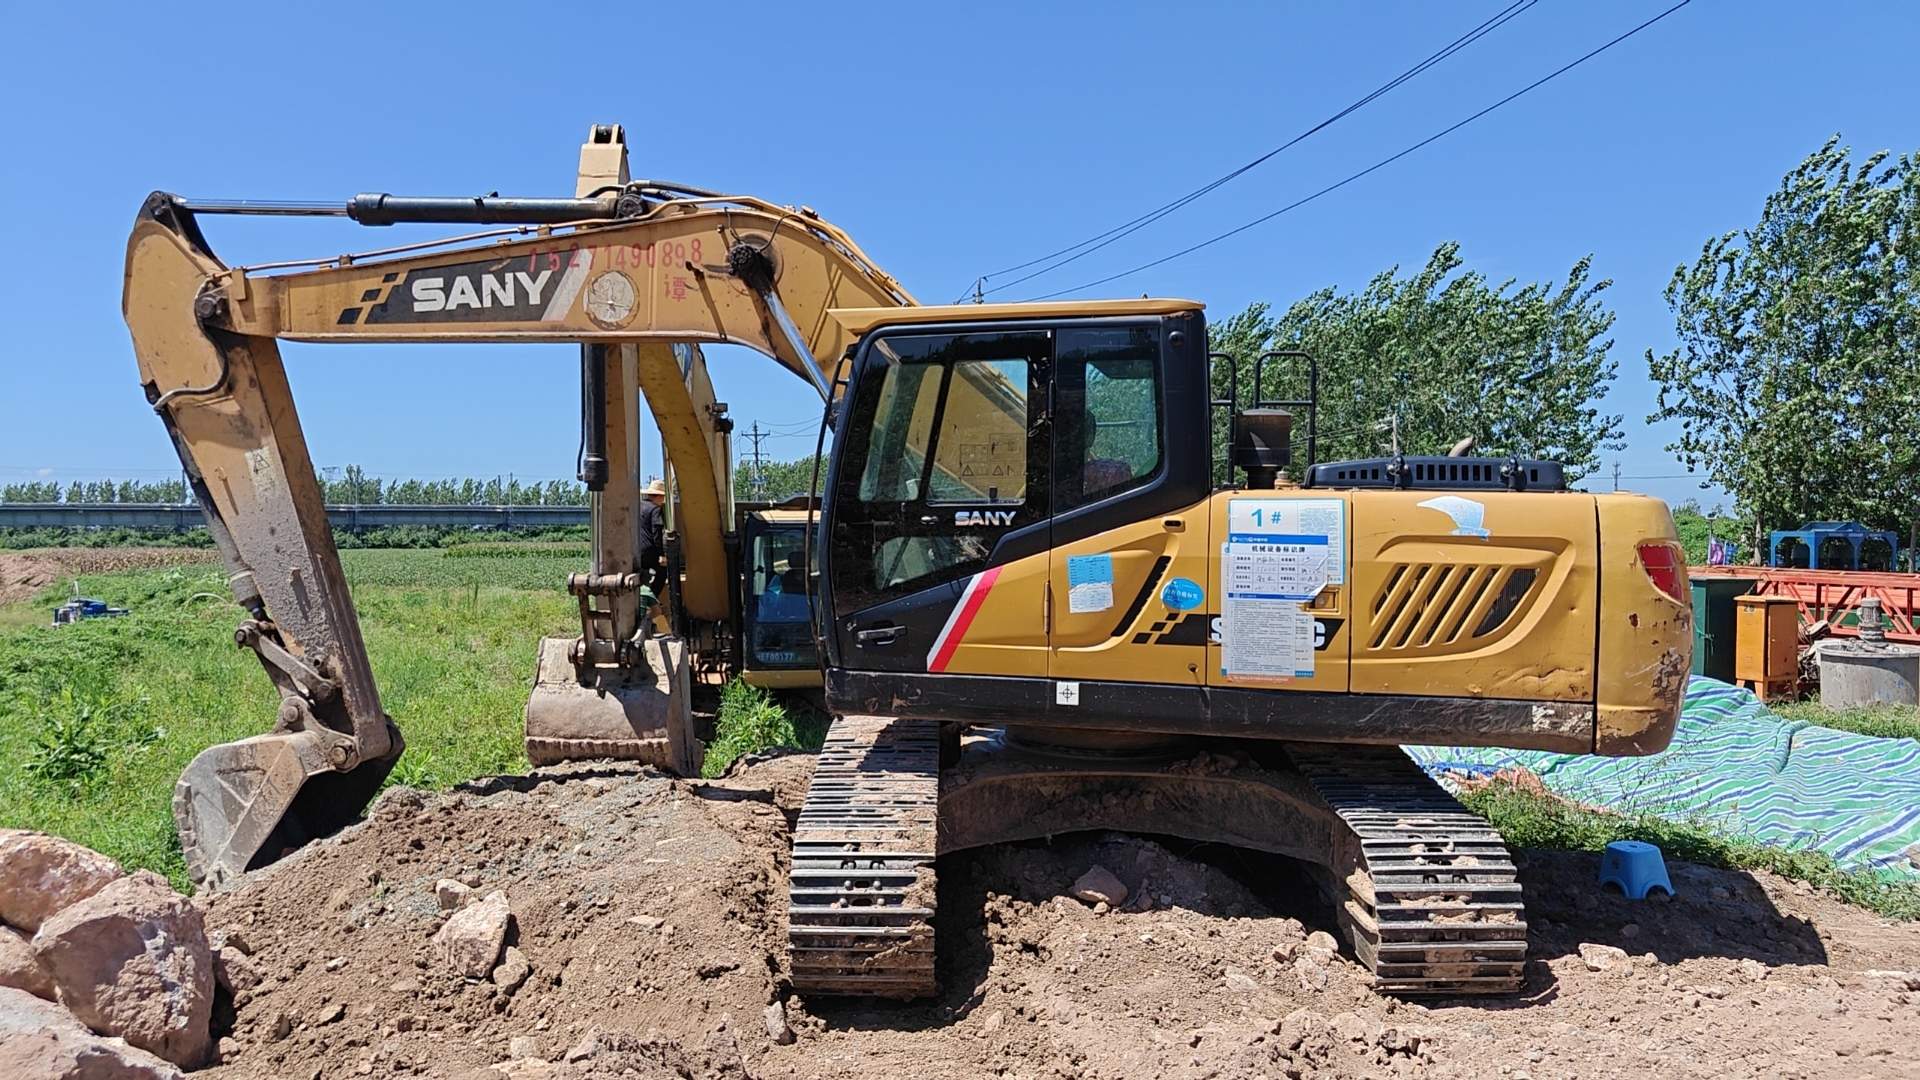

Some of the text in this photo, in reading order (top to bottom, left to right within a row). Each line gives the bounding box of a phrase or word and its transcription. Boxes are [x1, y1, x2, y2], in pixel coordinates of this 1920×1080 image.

[528, 238, 702, 273] 15271490898
[411, 269, 553, 313] SANY
[663, 273, 687, 303] 谭
[954, 510, 1017, 526] SANY
[1251, 545, 1306, 553] 机械设备标识牌
